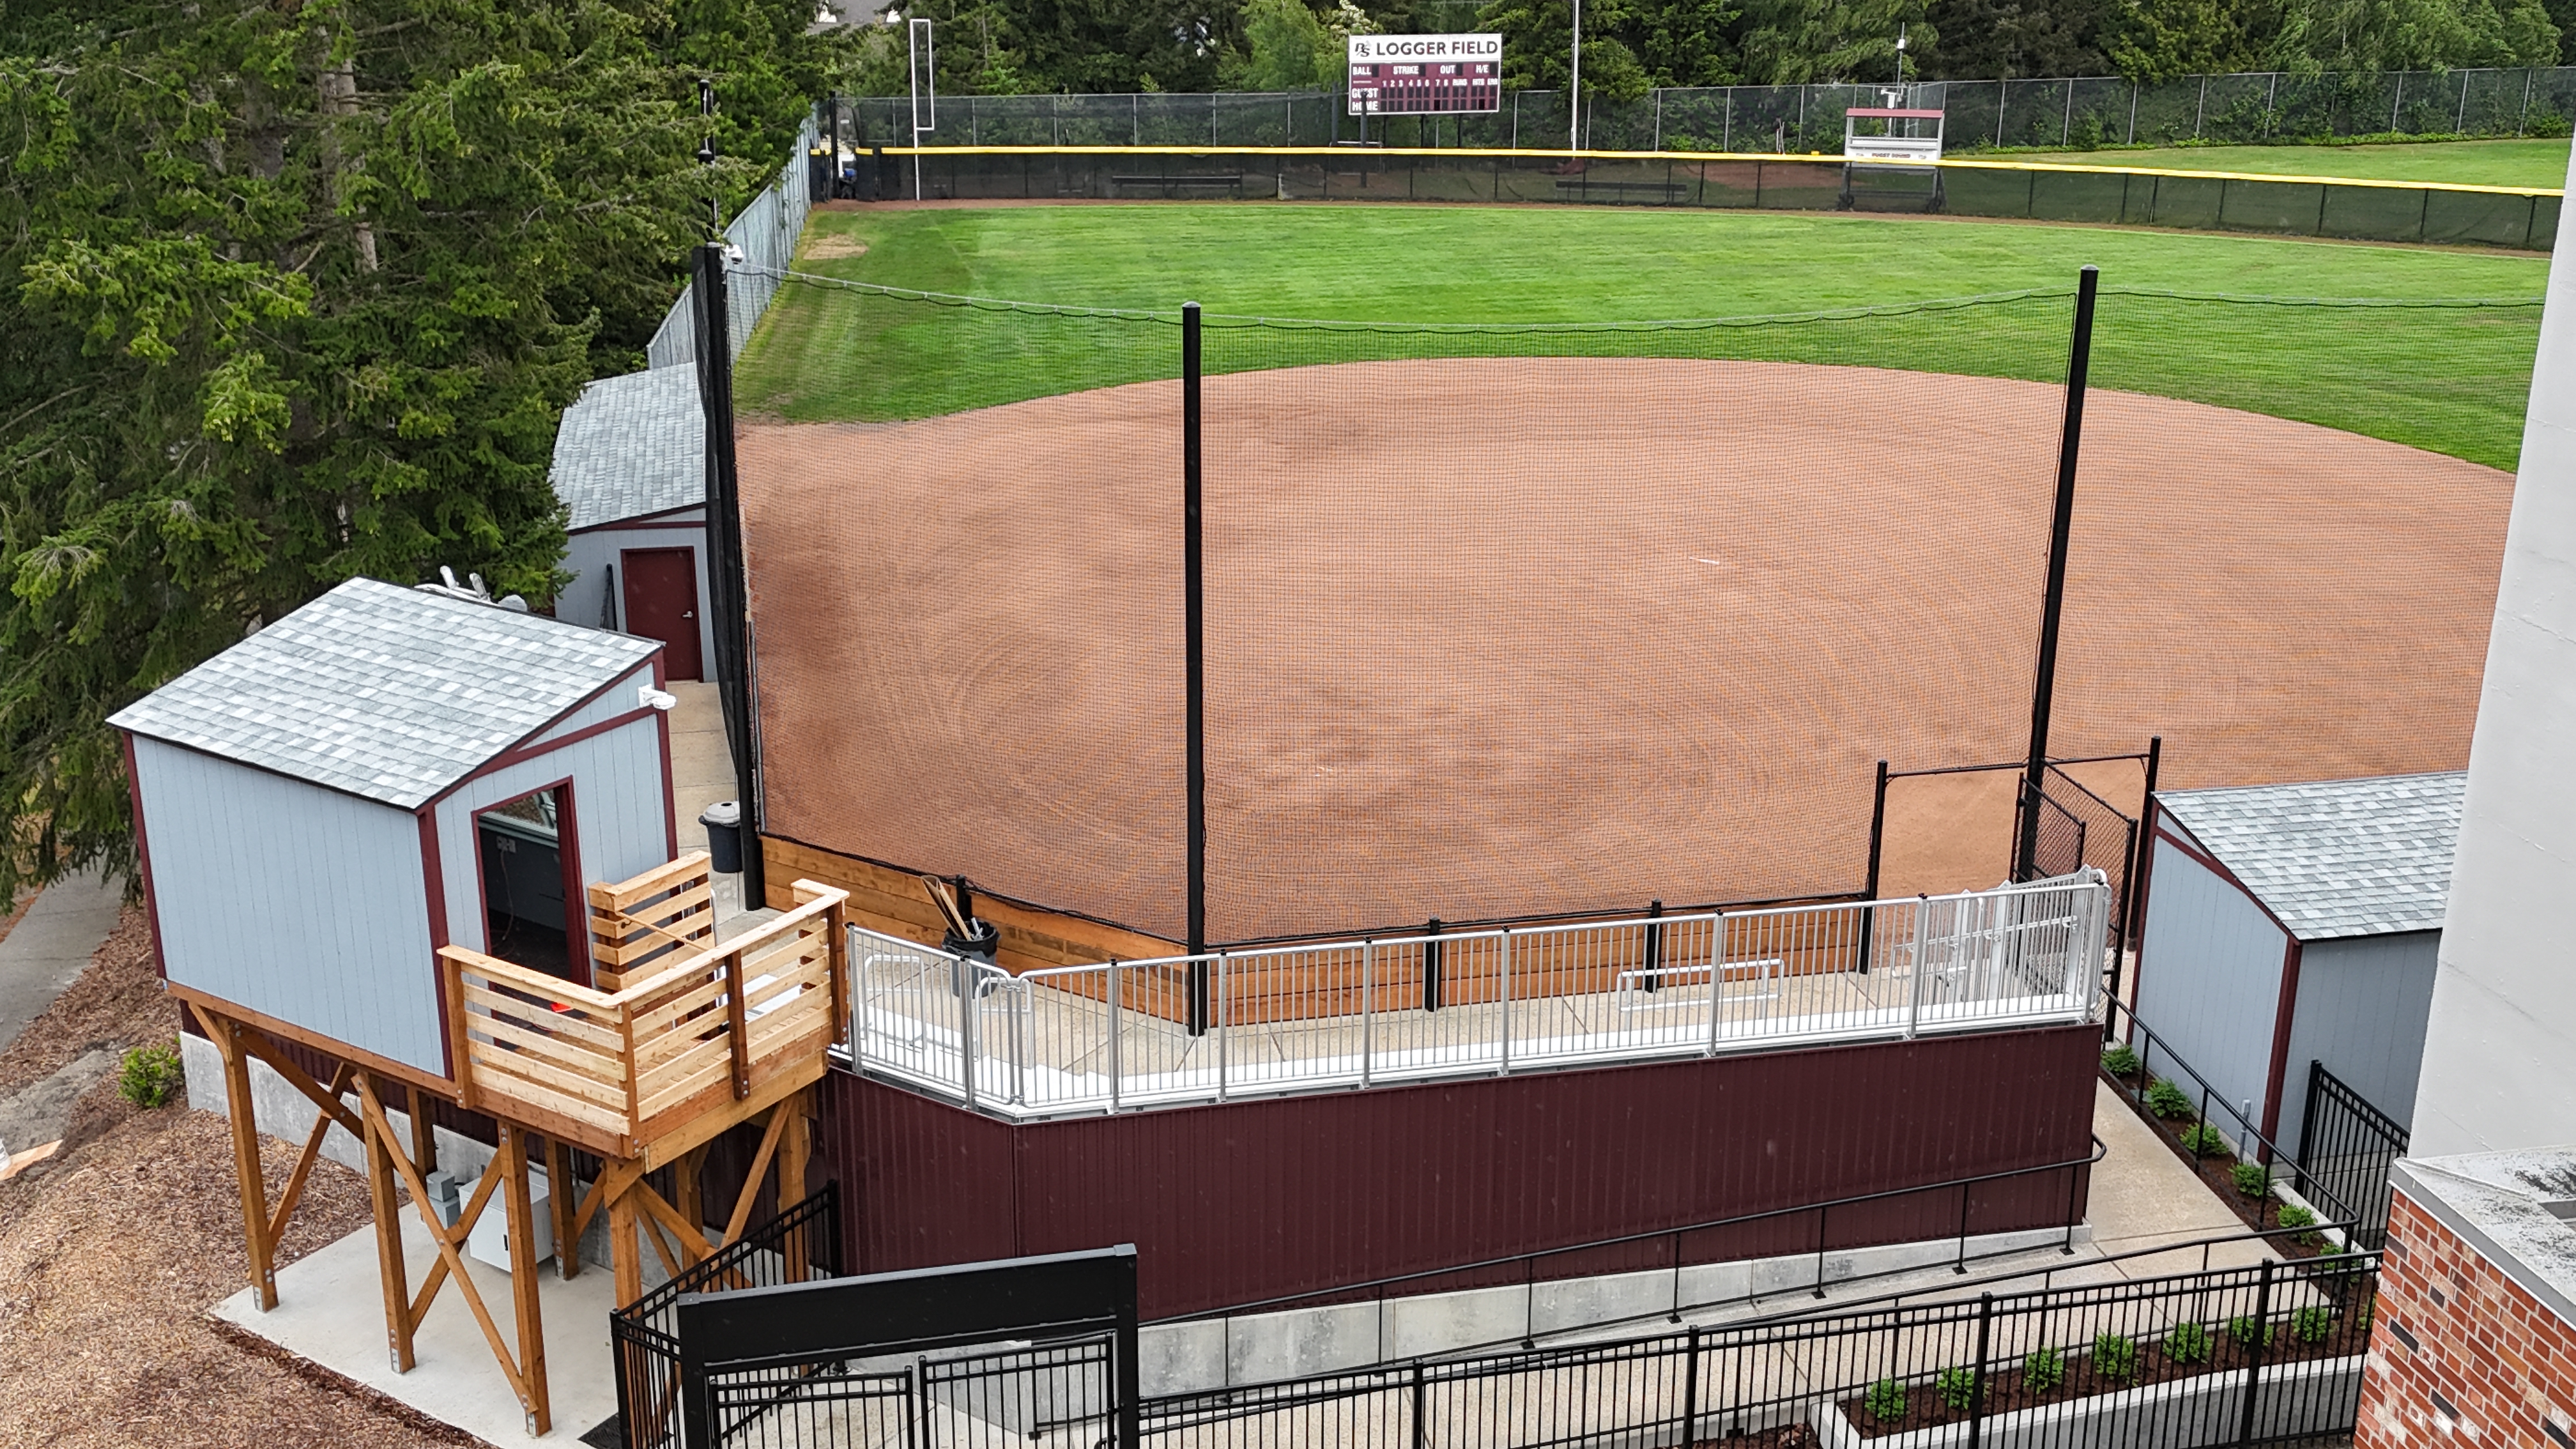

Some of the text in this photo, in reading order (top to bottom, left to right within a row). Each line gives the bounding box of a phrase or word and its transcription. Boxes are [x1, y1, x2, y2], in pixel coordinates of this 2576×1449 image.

[1377, 41, 1498, 56] LOGGER FIELD
[1353, 65, 1489, 75] BALL STRIKE OUT H/E
[1443, 79, 1448, 87] 8
